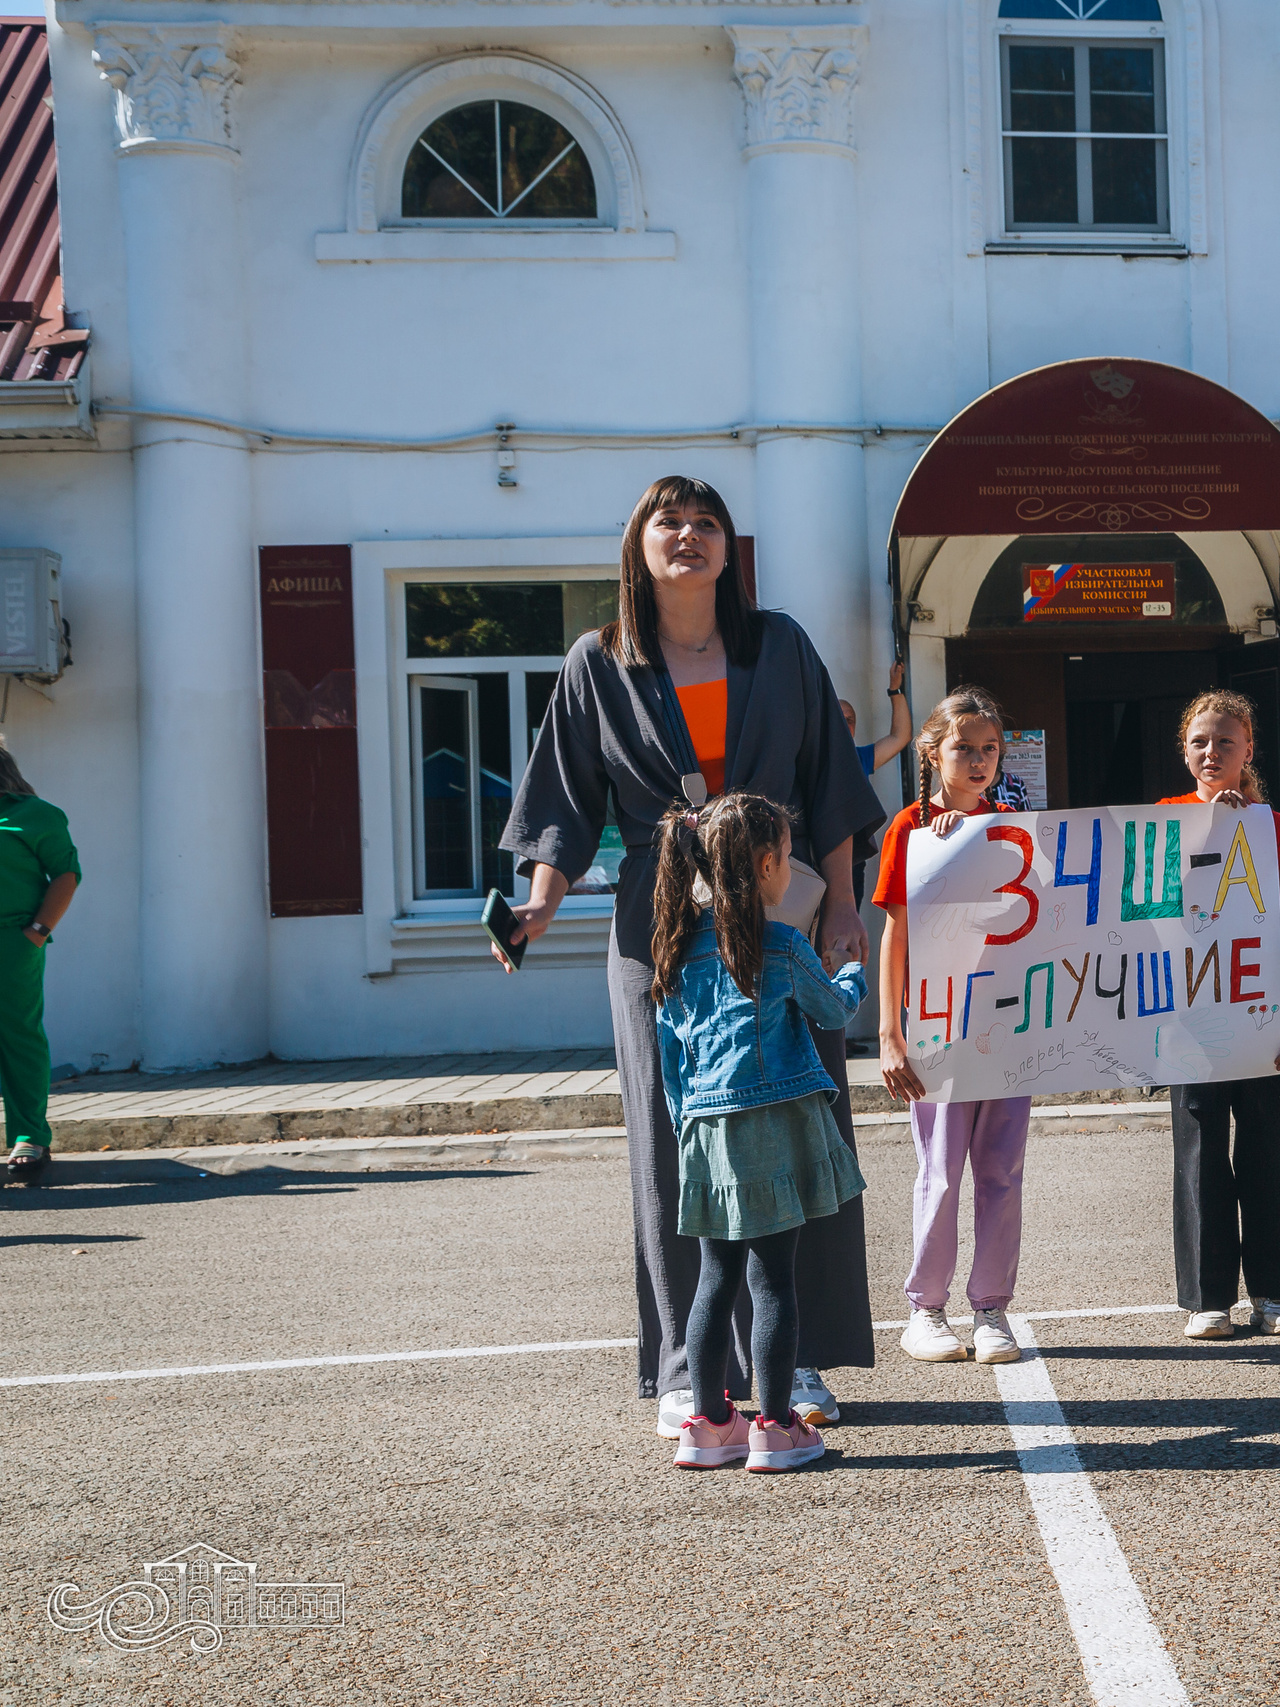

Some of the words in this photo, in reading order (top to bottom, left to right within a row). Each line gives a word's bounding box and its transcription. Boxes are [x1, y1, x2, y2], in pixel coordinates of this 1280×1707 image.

[945, 434, 1051, 446] МУНИЦИПАЛЬНОЕ
[1054, 434, 1128, 445] БЮДЖЕТНОЕ
[1131, 433, 1209, 444] УЧРЕЖДЕНИЕ
[1211, 432, 1272, 443] КУЛЬТУРЫ
[996, 465, 1134, 476] КУЛЬТУРНО-ДОСУГОВОЕ
[1135, 465, 1222, 476] ОБЪЕДИНЕНИЕ
[979, 485, 1100, 496] НОВОТИТАРОВСКОГО
[1102, 484, 1168, 494] СЕЛЬСКОГО
[1171, 483, 1240, 493] ПОСЕЛЕНИЯ
[1076, 568, 1152, 578] УЧАСТКОВАЯ
[266, 577, 344, 593] АФИША
[1065, 579, 1164, 589] ИЗБИРАТЕЛЬНАЯ
[1082, 590, 1148, 600] КОМИССИЯ
[1030, 606, 1096, 615] ИЗБИРАТЕЛЬНОГО
[1098, 606, 1130, 614] УЧАСТКА
